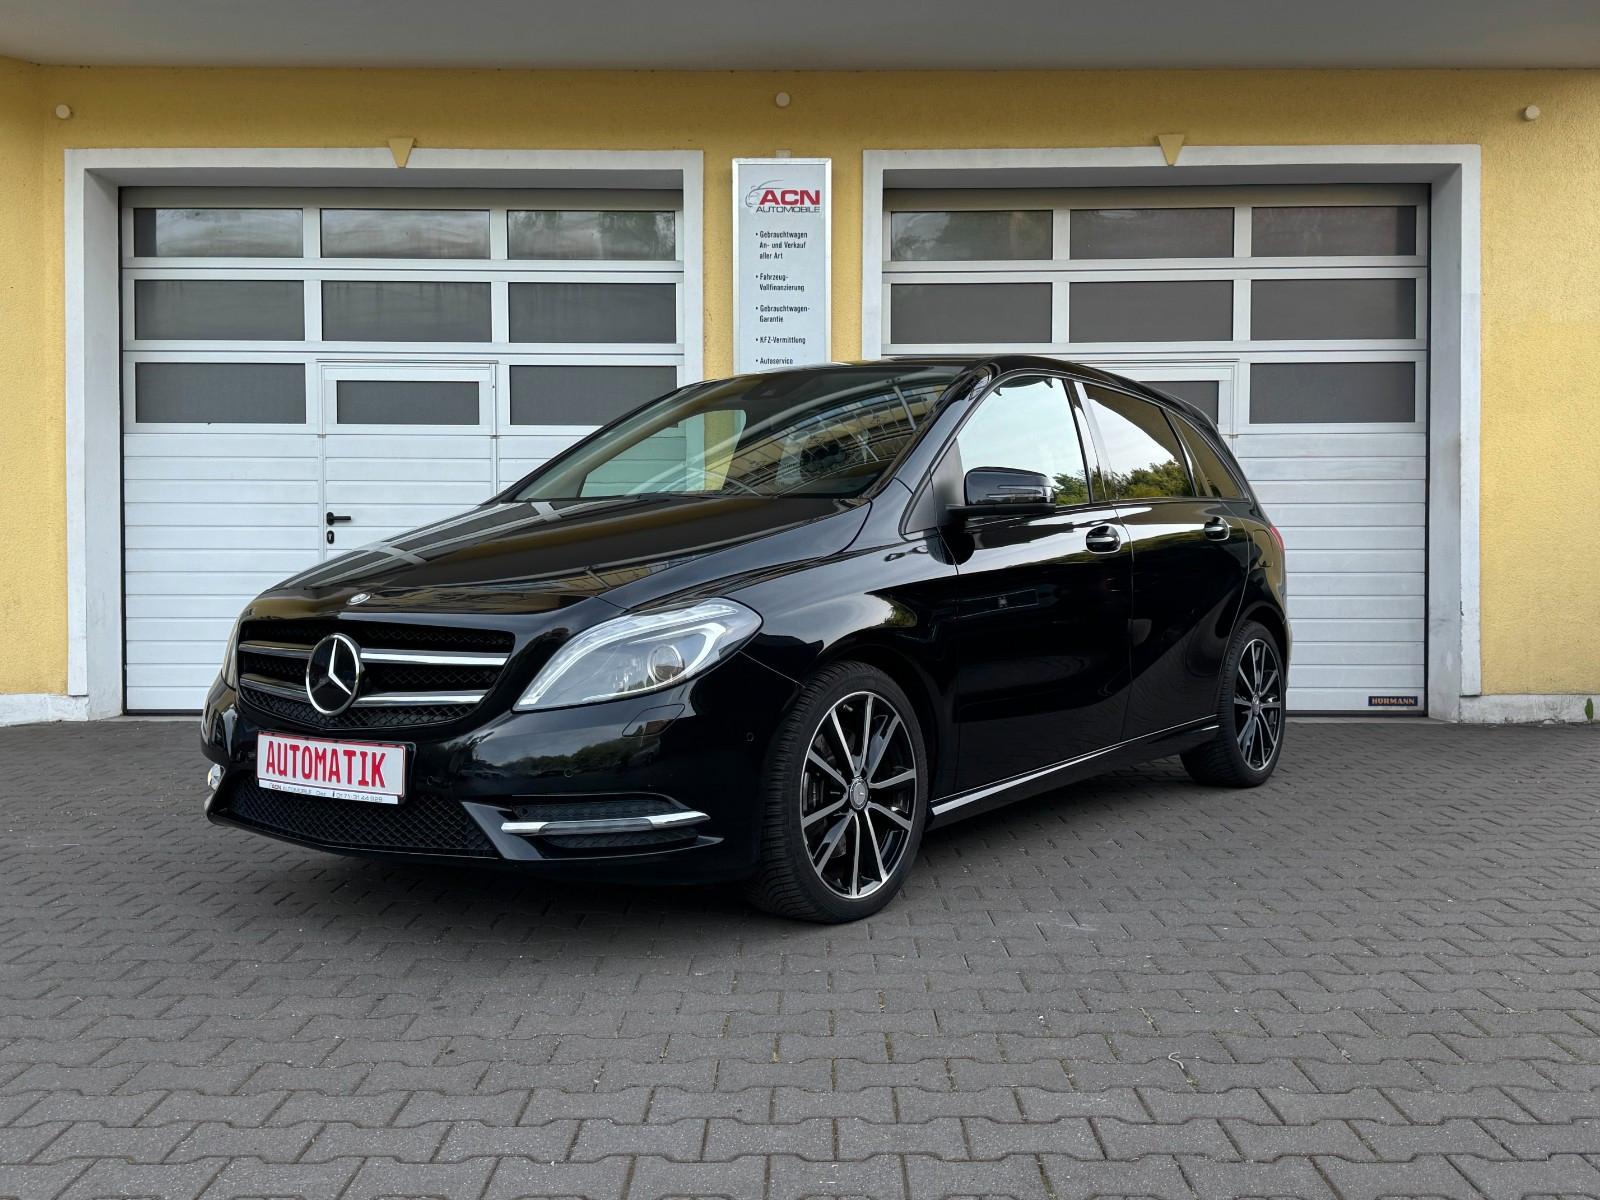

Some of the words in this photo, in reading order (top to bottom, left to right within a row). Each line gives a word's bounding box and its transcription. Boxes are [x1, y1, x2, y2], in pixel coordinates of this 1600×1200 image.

[759, 190, 820, 206] ACN
[760, 231, 808, 239] Gebrauchtwagen
[772, 241, 783, 249] und
[784, 241, 806, 249] Verkauf
[760, 273, 789, 281] Fahrzeug-
[760, 305, 810, 313] Gebrauchtwagen-
[760, 315, 784, 323] Garantie
[760, 336, 806, 344] KFZ-Vermittlung
[760, 357, 793, 365] Autoservice
[266, 740, 386, 788] AUTOMATIK
